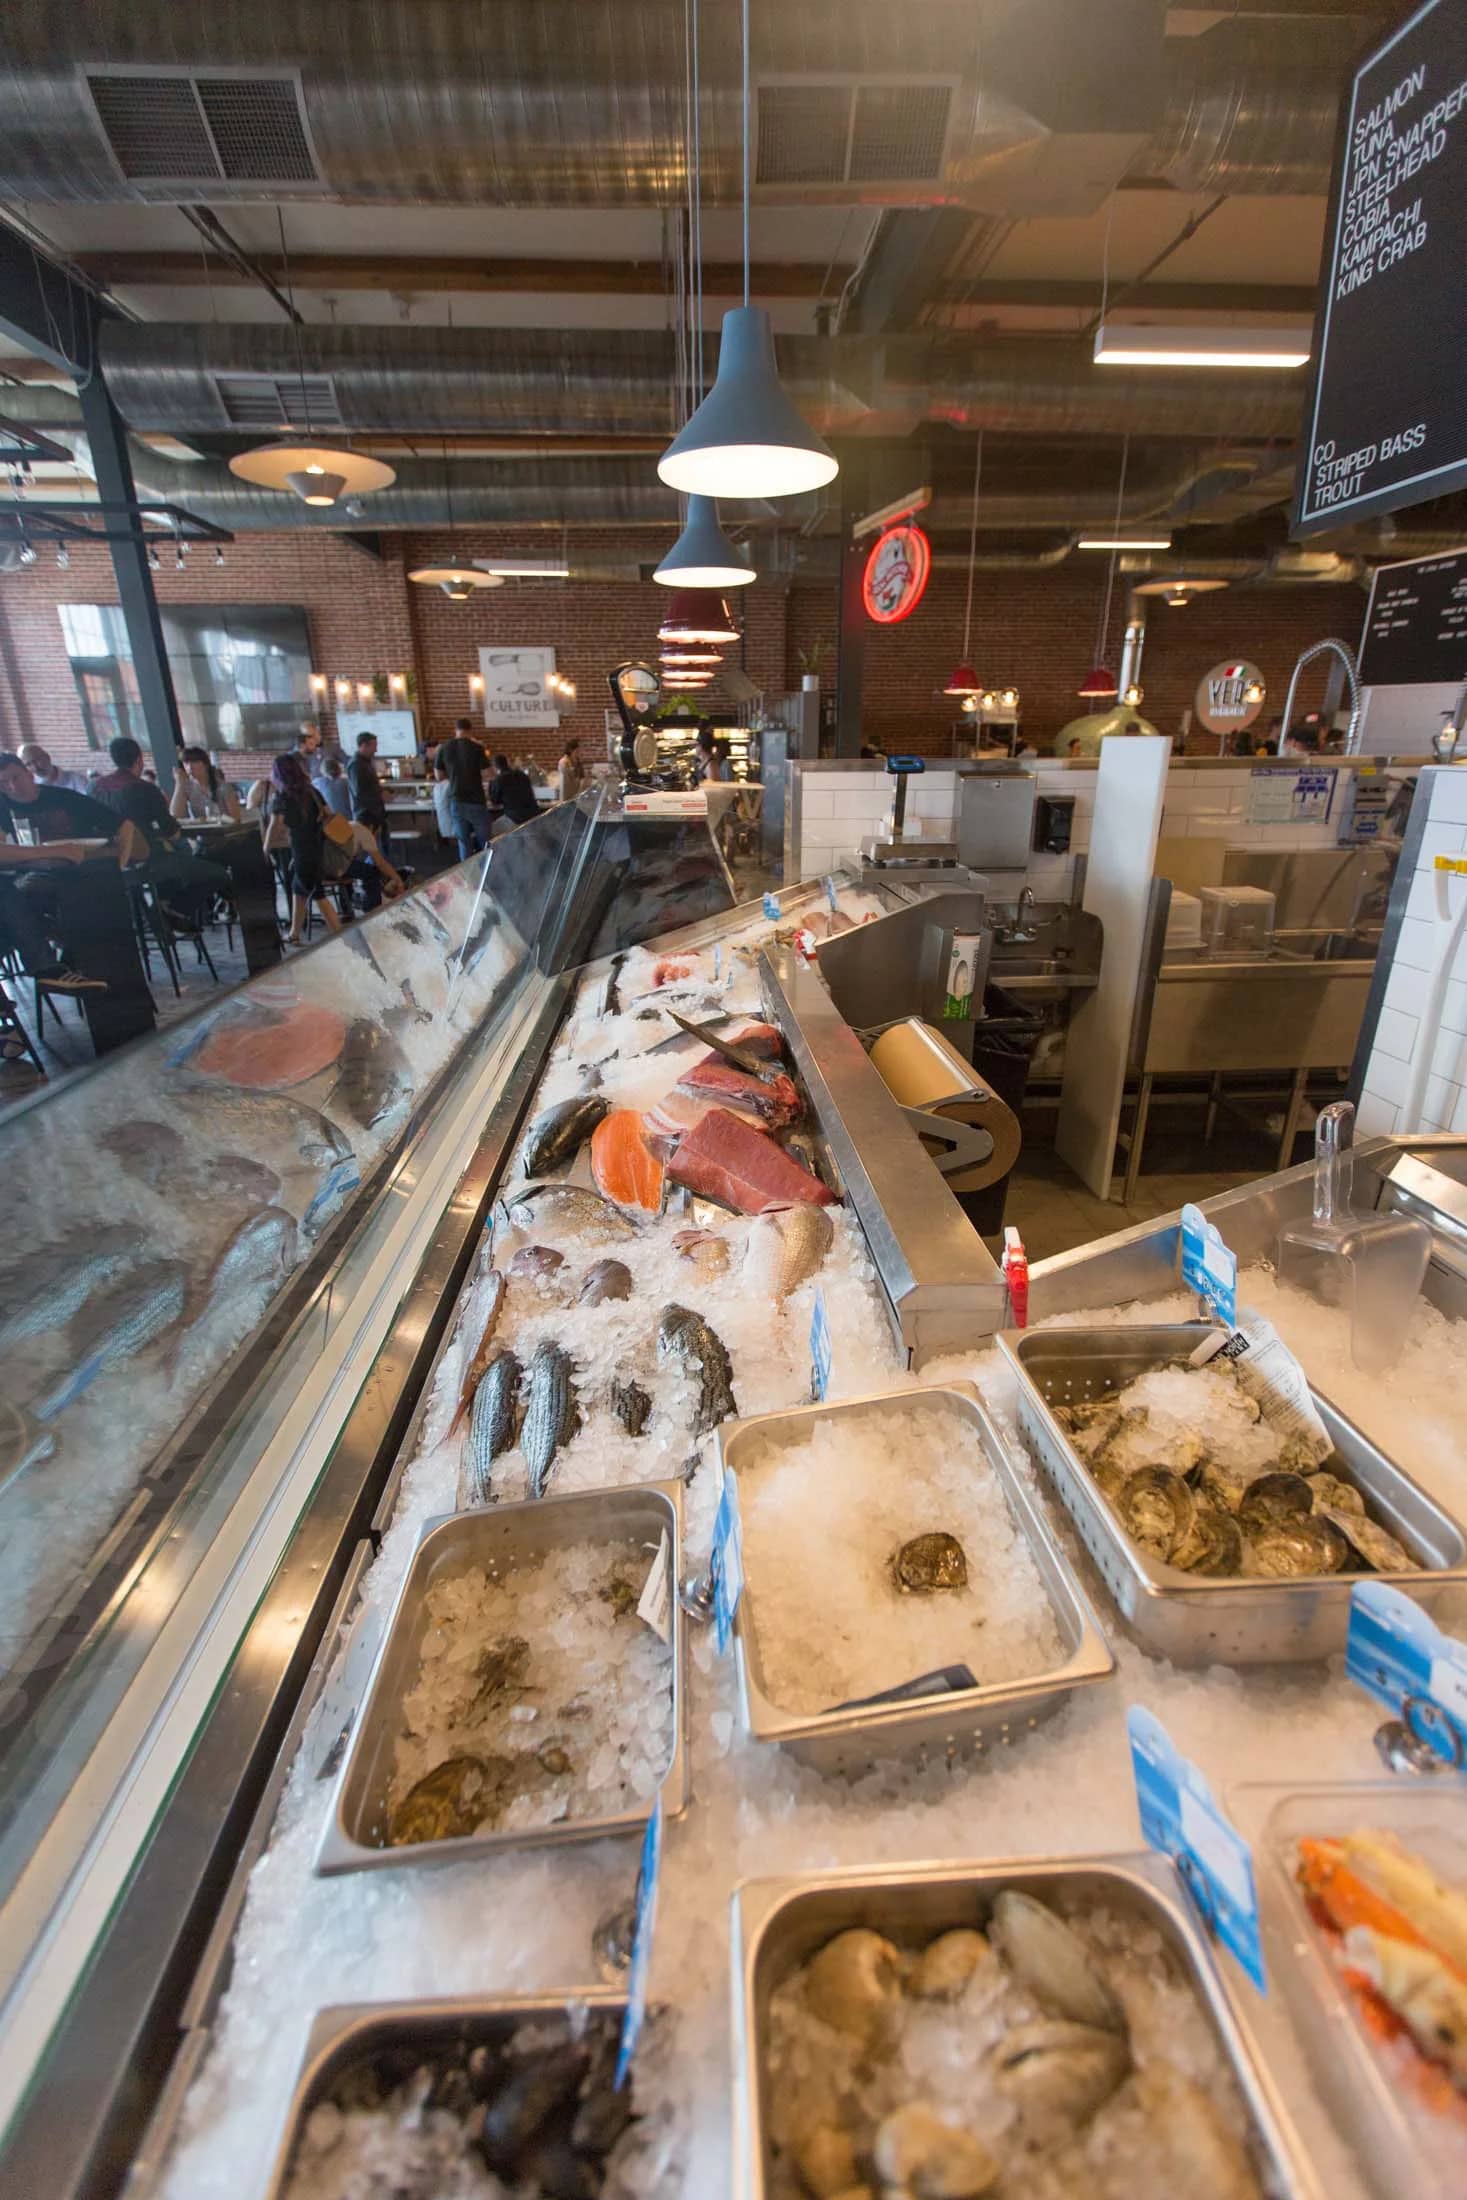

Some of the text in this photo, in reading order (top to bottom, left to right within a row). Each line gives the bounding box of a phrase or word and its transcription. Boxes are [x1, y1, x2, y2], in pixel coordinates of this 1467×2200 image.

[1354, 64, 1426, 144] SALMON
[1345, 129, 1446, 224] STEELHEAD
[1349, 155, 1380, 198] JPN
[1353, 122, 1394, 169] TUNA
[1340, 198, 1422, 275] KAMPACHI
[1342, 198, 1390, 249] COBIA
[1336, 222, 1427, 300] KING CRAB
[1316, 424, 1427, 487] STRIPED BASS
[1314, 472, 1366, 509] TROUT
